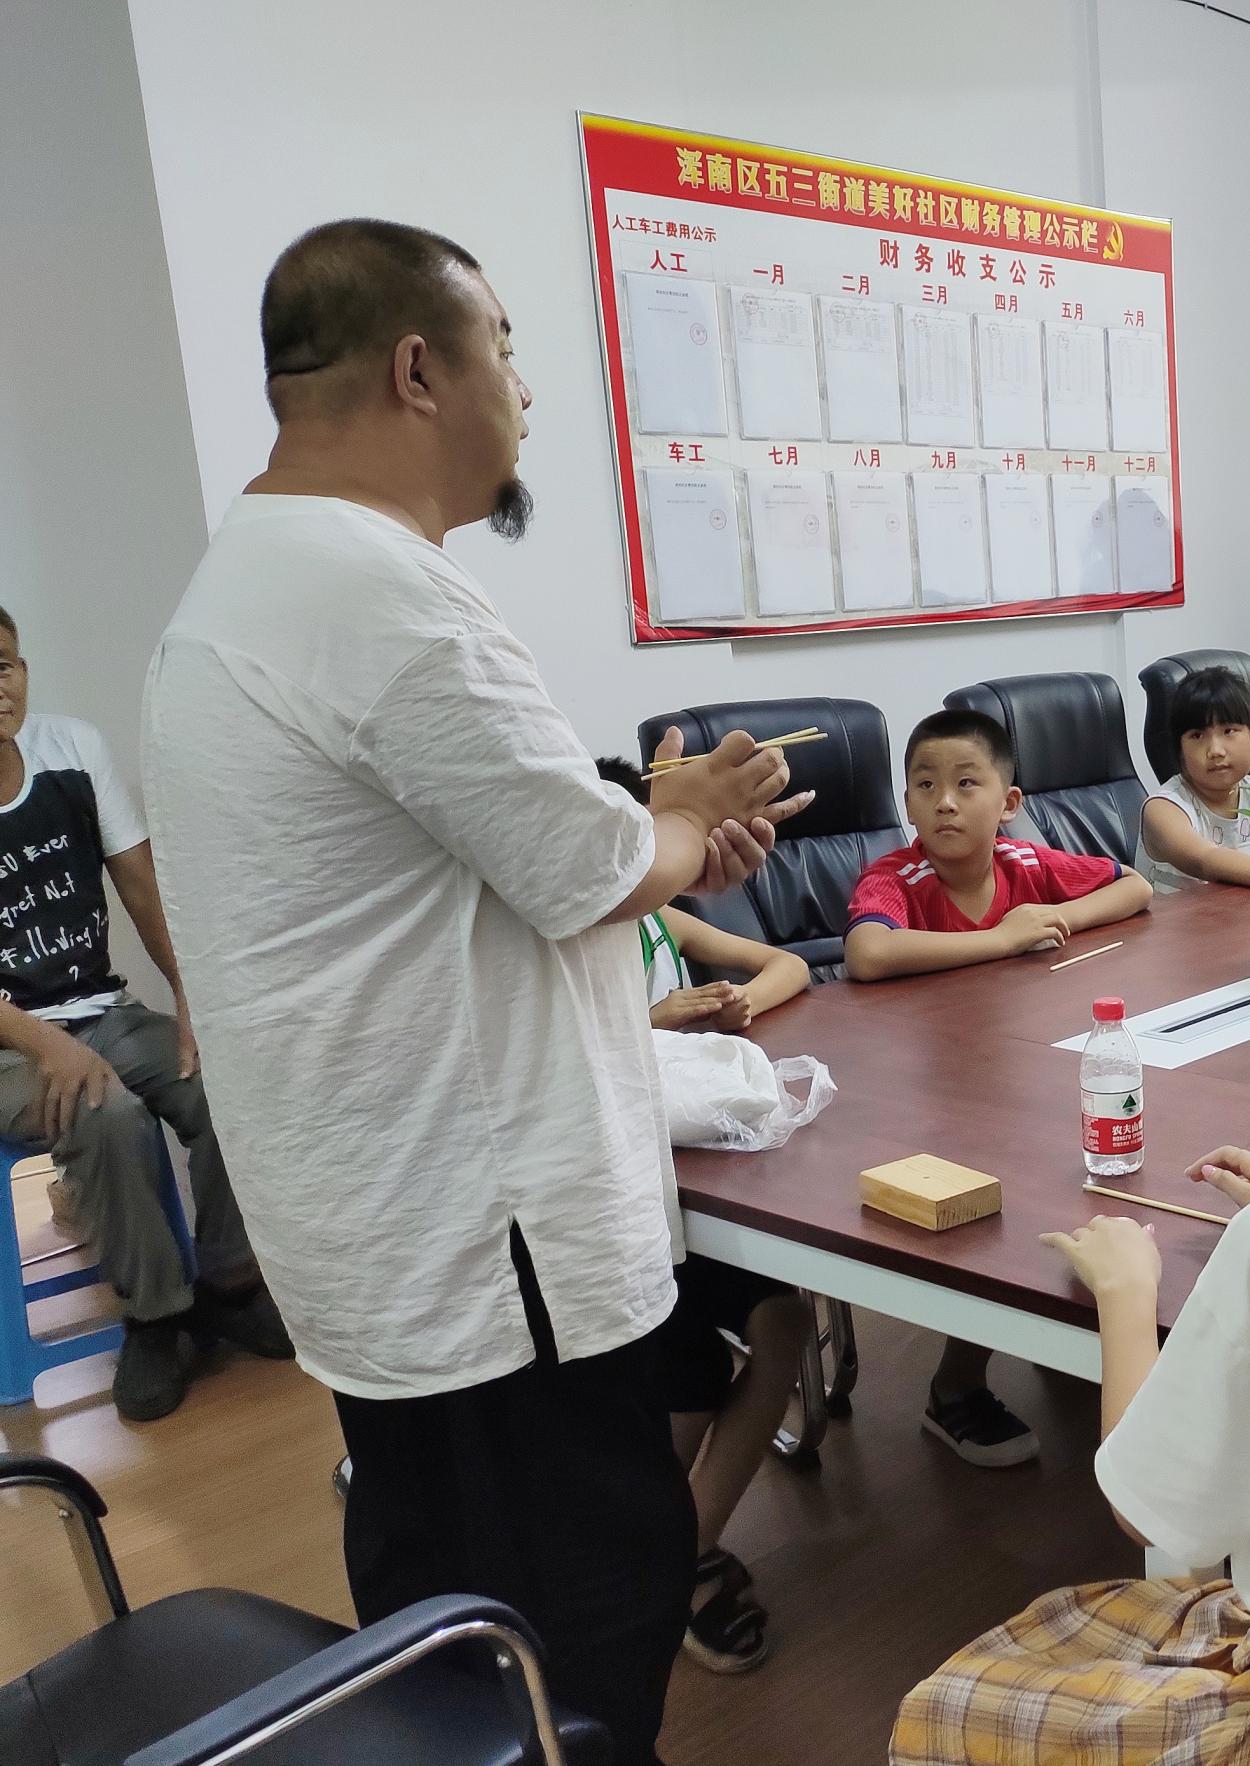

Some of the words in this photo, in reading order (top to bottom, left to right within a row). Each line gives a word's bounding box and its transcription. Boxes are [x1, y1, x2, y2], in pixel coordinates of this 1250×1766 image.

[676, 146, 1098, 253] 浑南区五三街道美好社区财务管理公示栏
[611, 213, 717, 243] 人工车工费用公示
[649, 250, 688, 273] 人工
[879, 238, 1057, 289] 财务收支公示
[752, 264, 785, 286] 一月
[842, 275, 871, 296] 二月
[922, 285, 948, 305] 三月
[994, 293, 1019, 313] 四月
[1061, 301, 1084, 321] 五月
[1123, 310, 1145, 328] 六月
[668, 442, 705, 464] 车工
[768, 446, 799, 466] 七月
[853, 448, 881, 468] 八月
[931, 450, 957, 470] 九月
[1002, 452, 1026, 471] 十月
[1062, 455, 1096, 472] 十一月
[1124, 456, 1157, 473] 十二月
[0, 885, 36, 928] gret
[44, 871, 76, 900] Not
